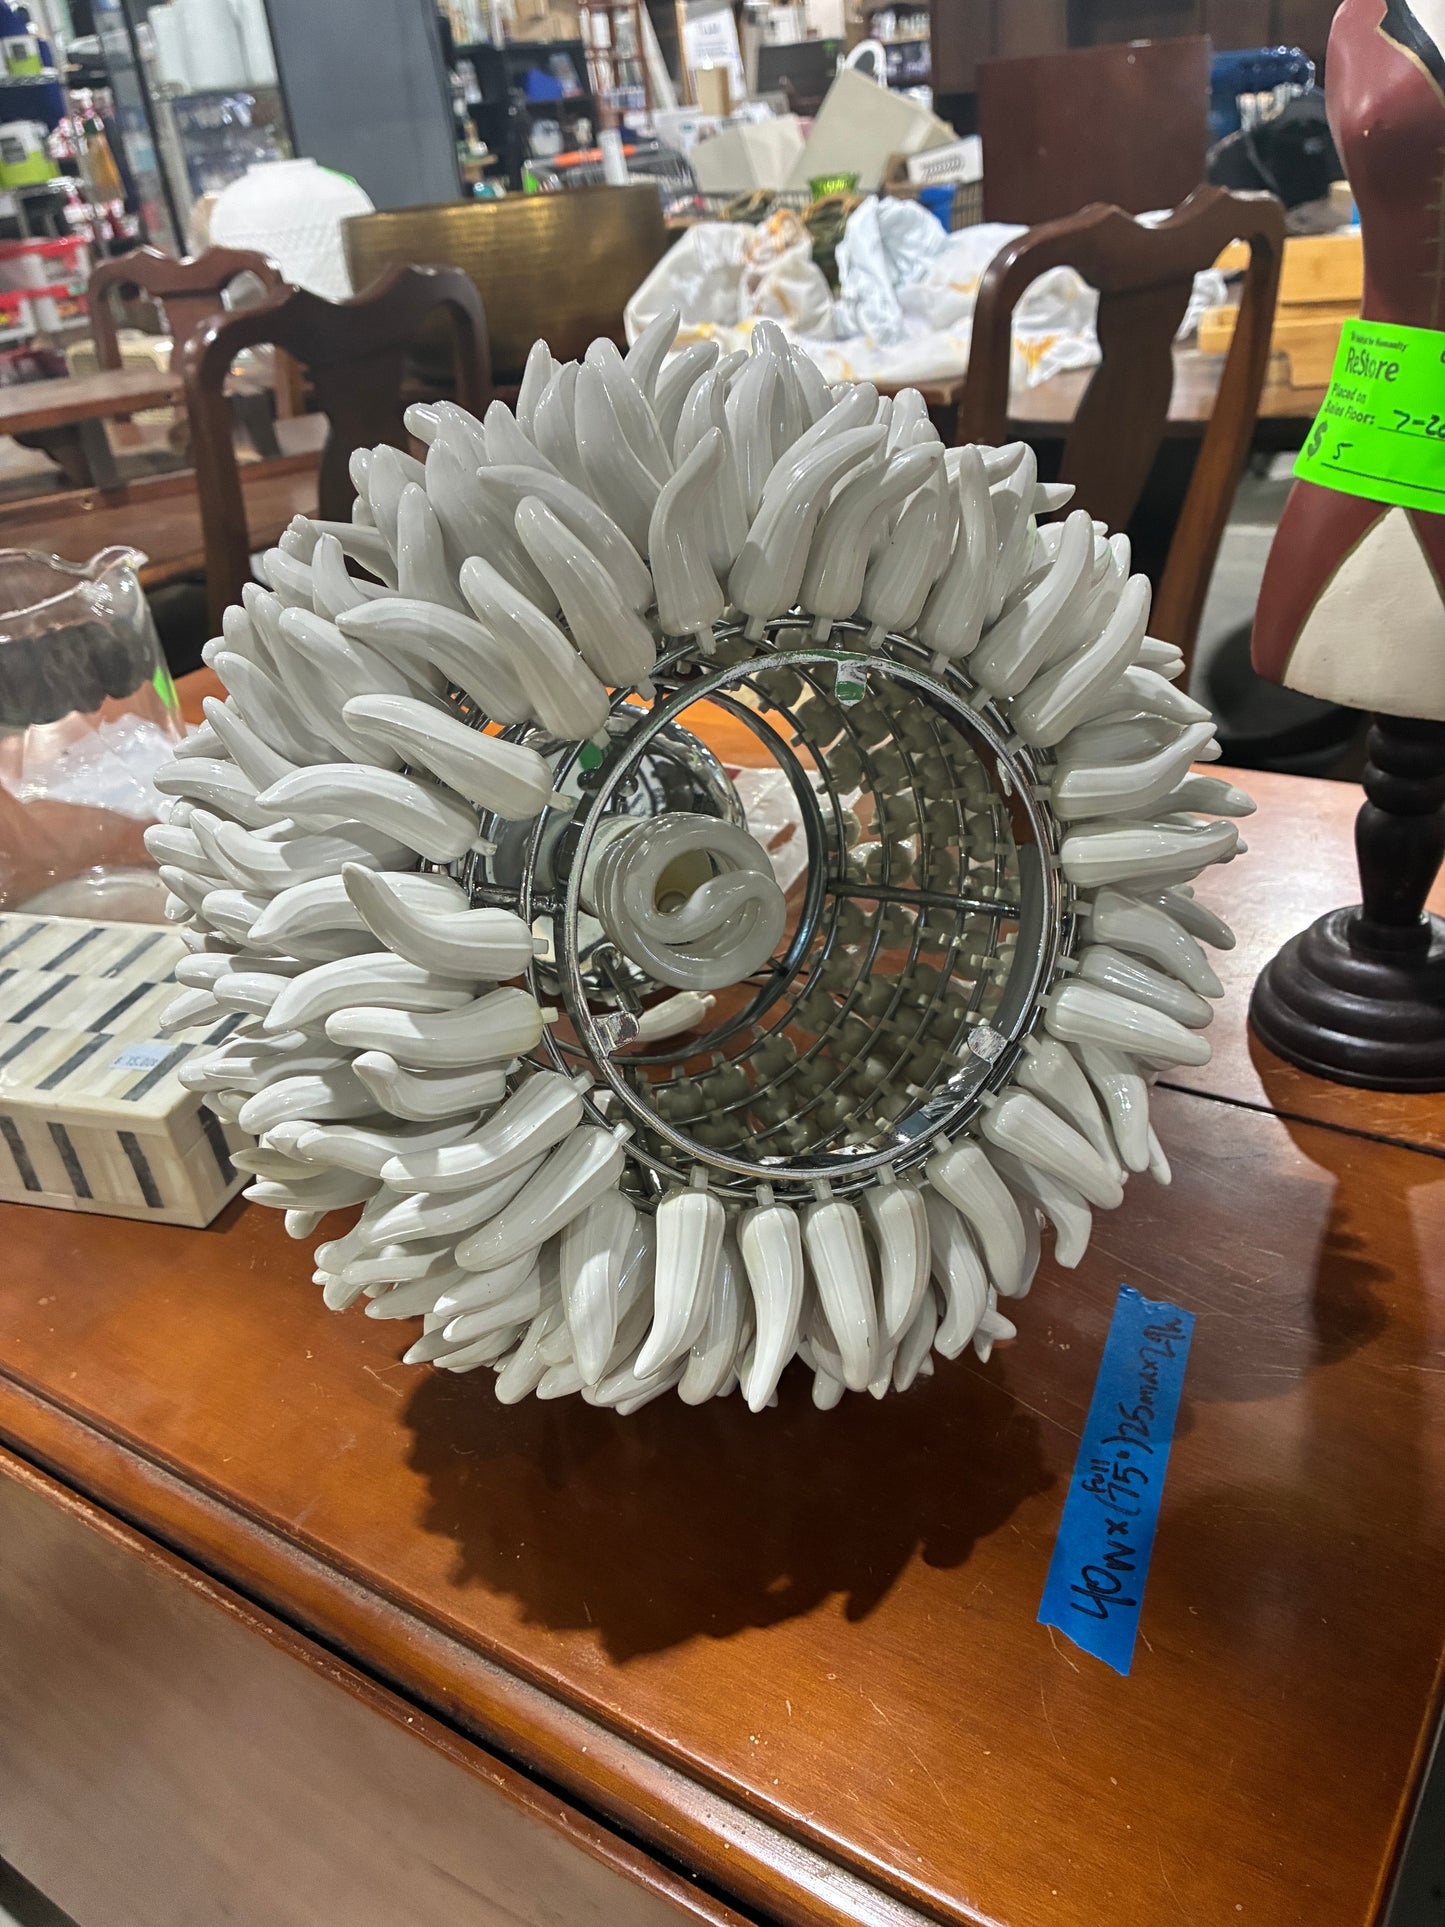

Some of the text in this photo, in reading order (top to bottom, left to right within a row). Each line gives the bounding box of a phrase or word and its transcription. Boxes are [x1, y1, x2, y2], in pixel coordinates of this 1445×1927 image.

[1345, 346, 1400, 382] ReStore
[1331, 382, 1367, 405] Placed on
[1324, 400, 1345, 417] Sales
[1345, 405, 1376, 425] Floor:
[1306, 419, 1354, 462] $ 5
